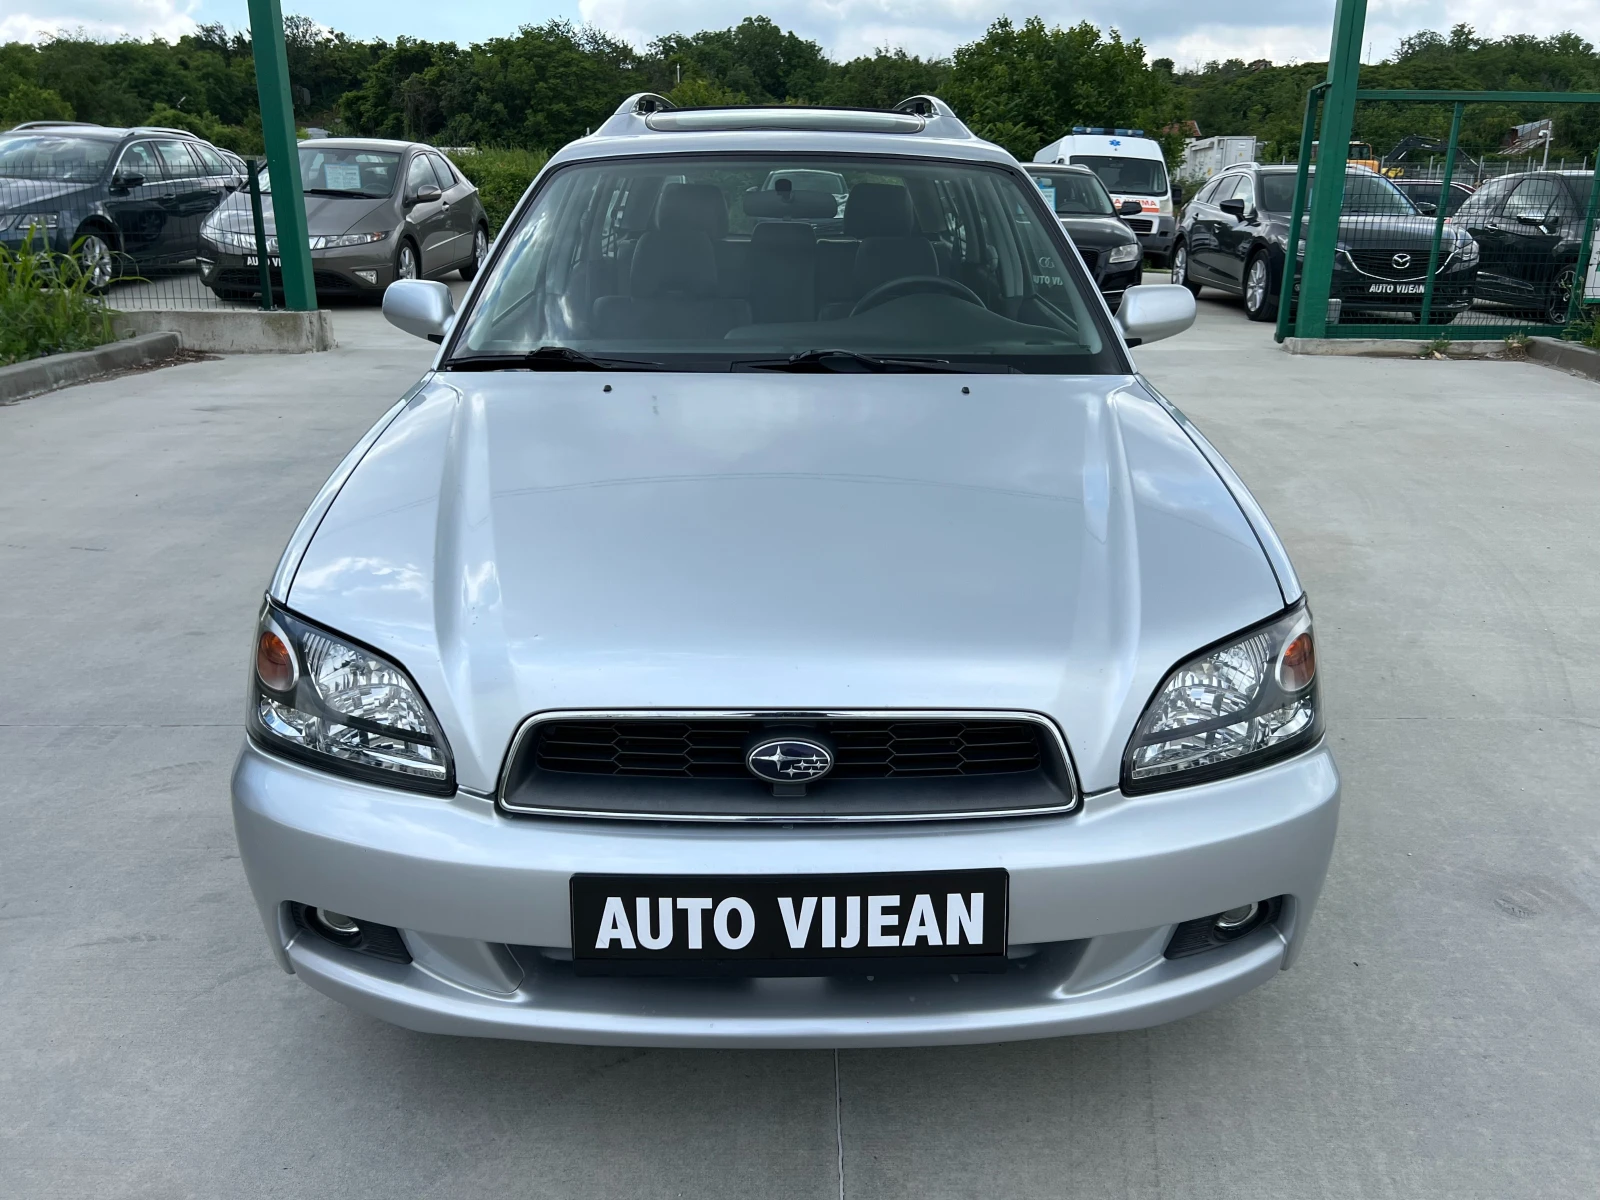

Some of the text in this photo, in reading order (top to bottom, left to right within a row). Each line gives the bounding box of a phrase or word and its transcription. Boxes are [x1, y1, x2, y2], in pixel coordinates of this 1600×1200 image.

[1033, 275, 1050, 285] UTO
[1369, 284, 1425, 294] AUTO VIJEAN
[595, 893, 984, 950] AUTO VIJEAN
